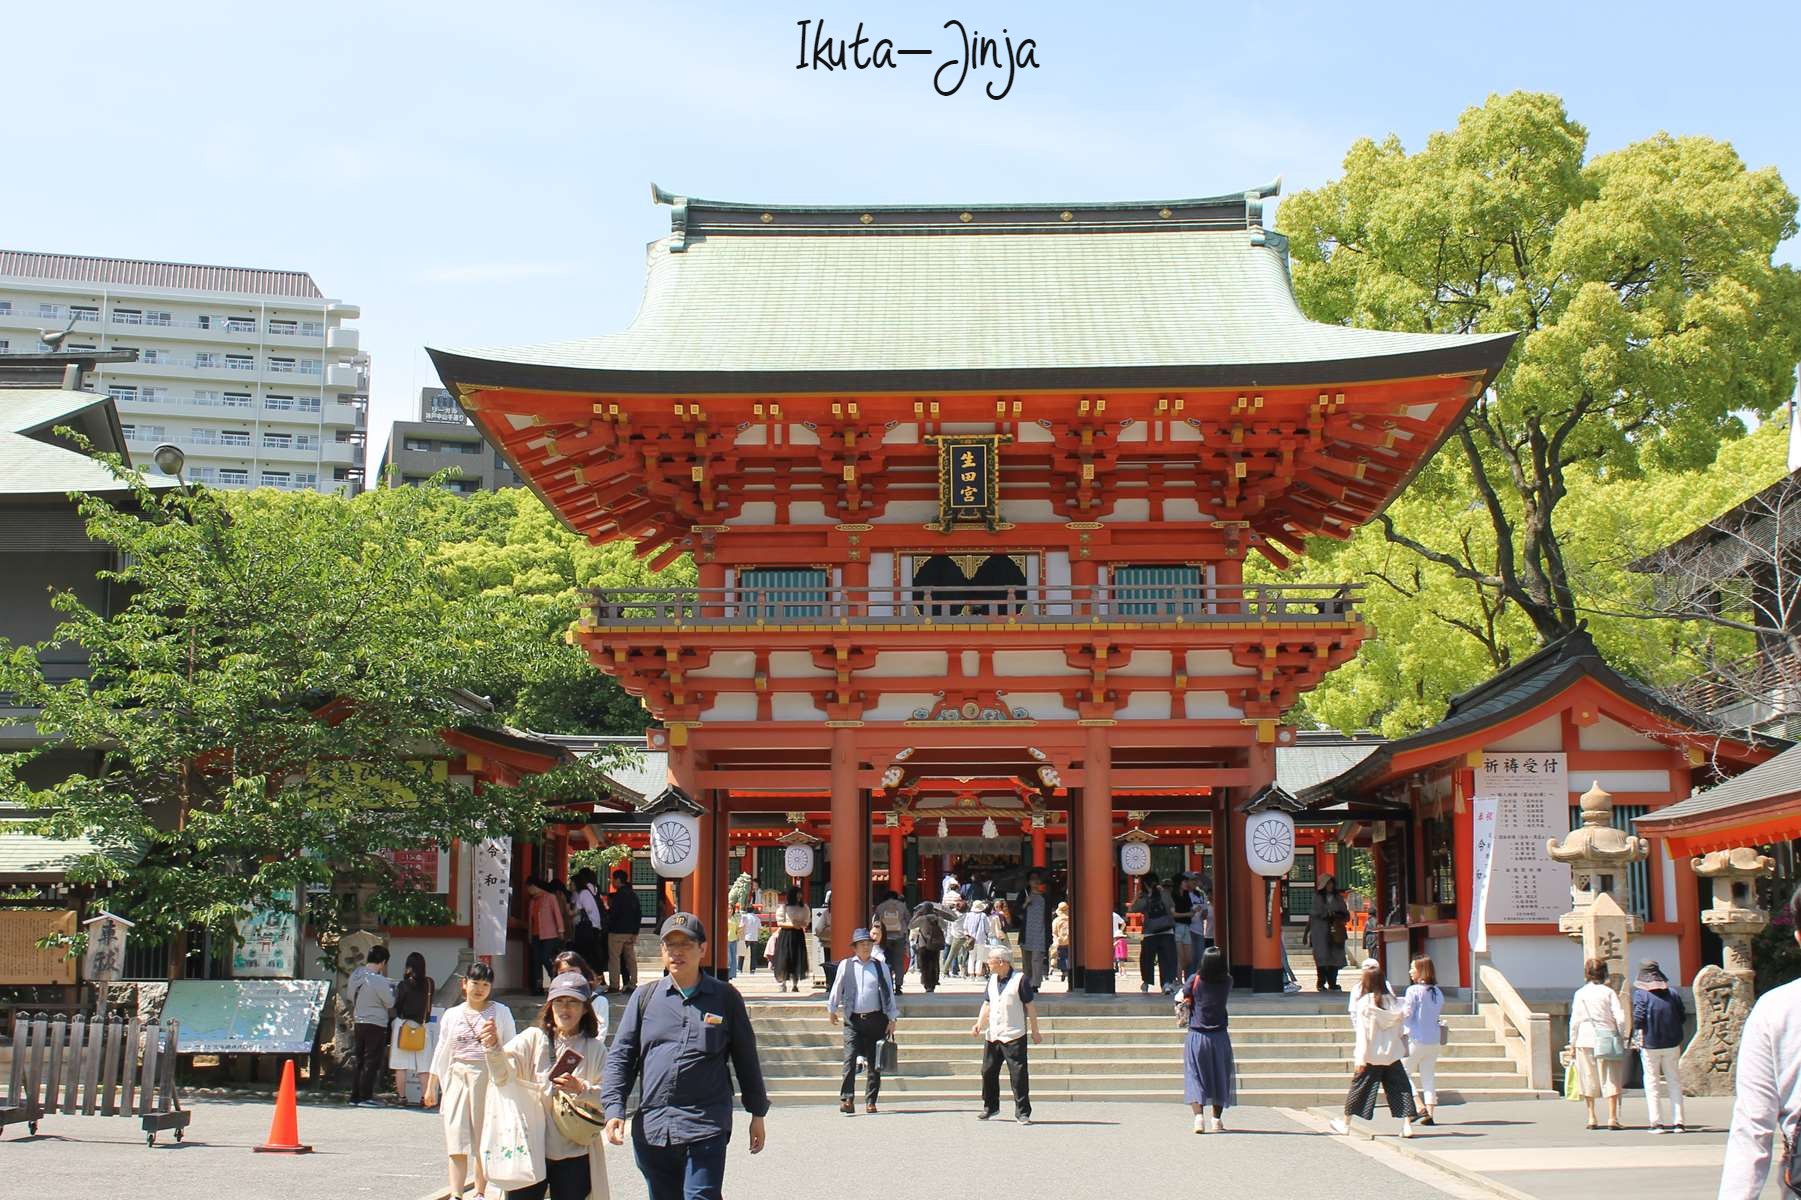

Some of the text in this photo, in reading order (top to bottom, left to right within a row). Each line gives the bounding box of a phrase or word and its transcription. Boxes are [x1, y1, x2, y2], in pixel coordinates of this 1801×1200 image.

[960, 451, 978, 502] 生田宮
[484, 844, 499, 887] 令和
[1704, 977, 1734, 1074] 百度石
